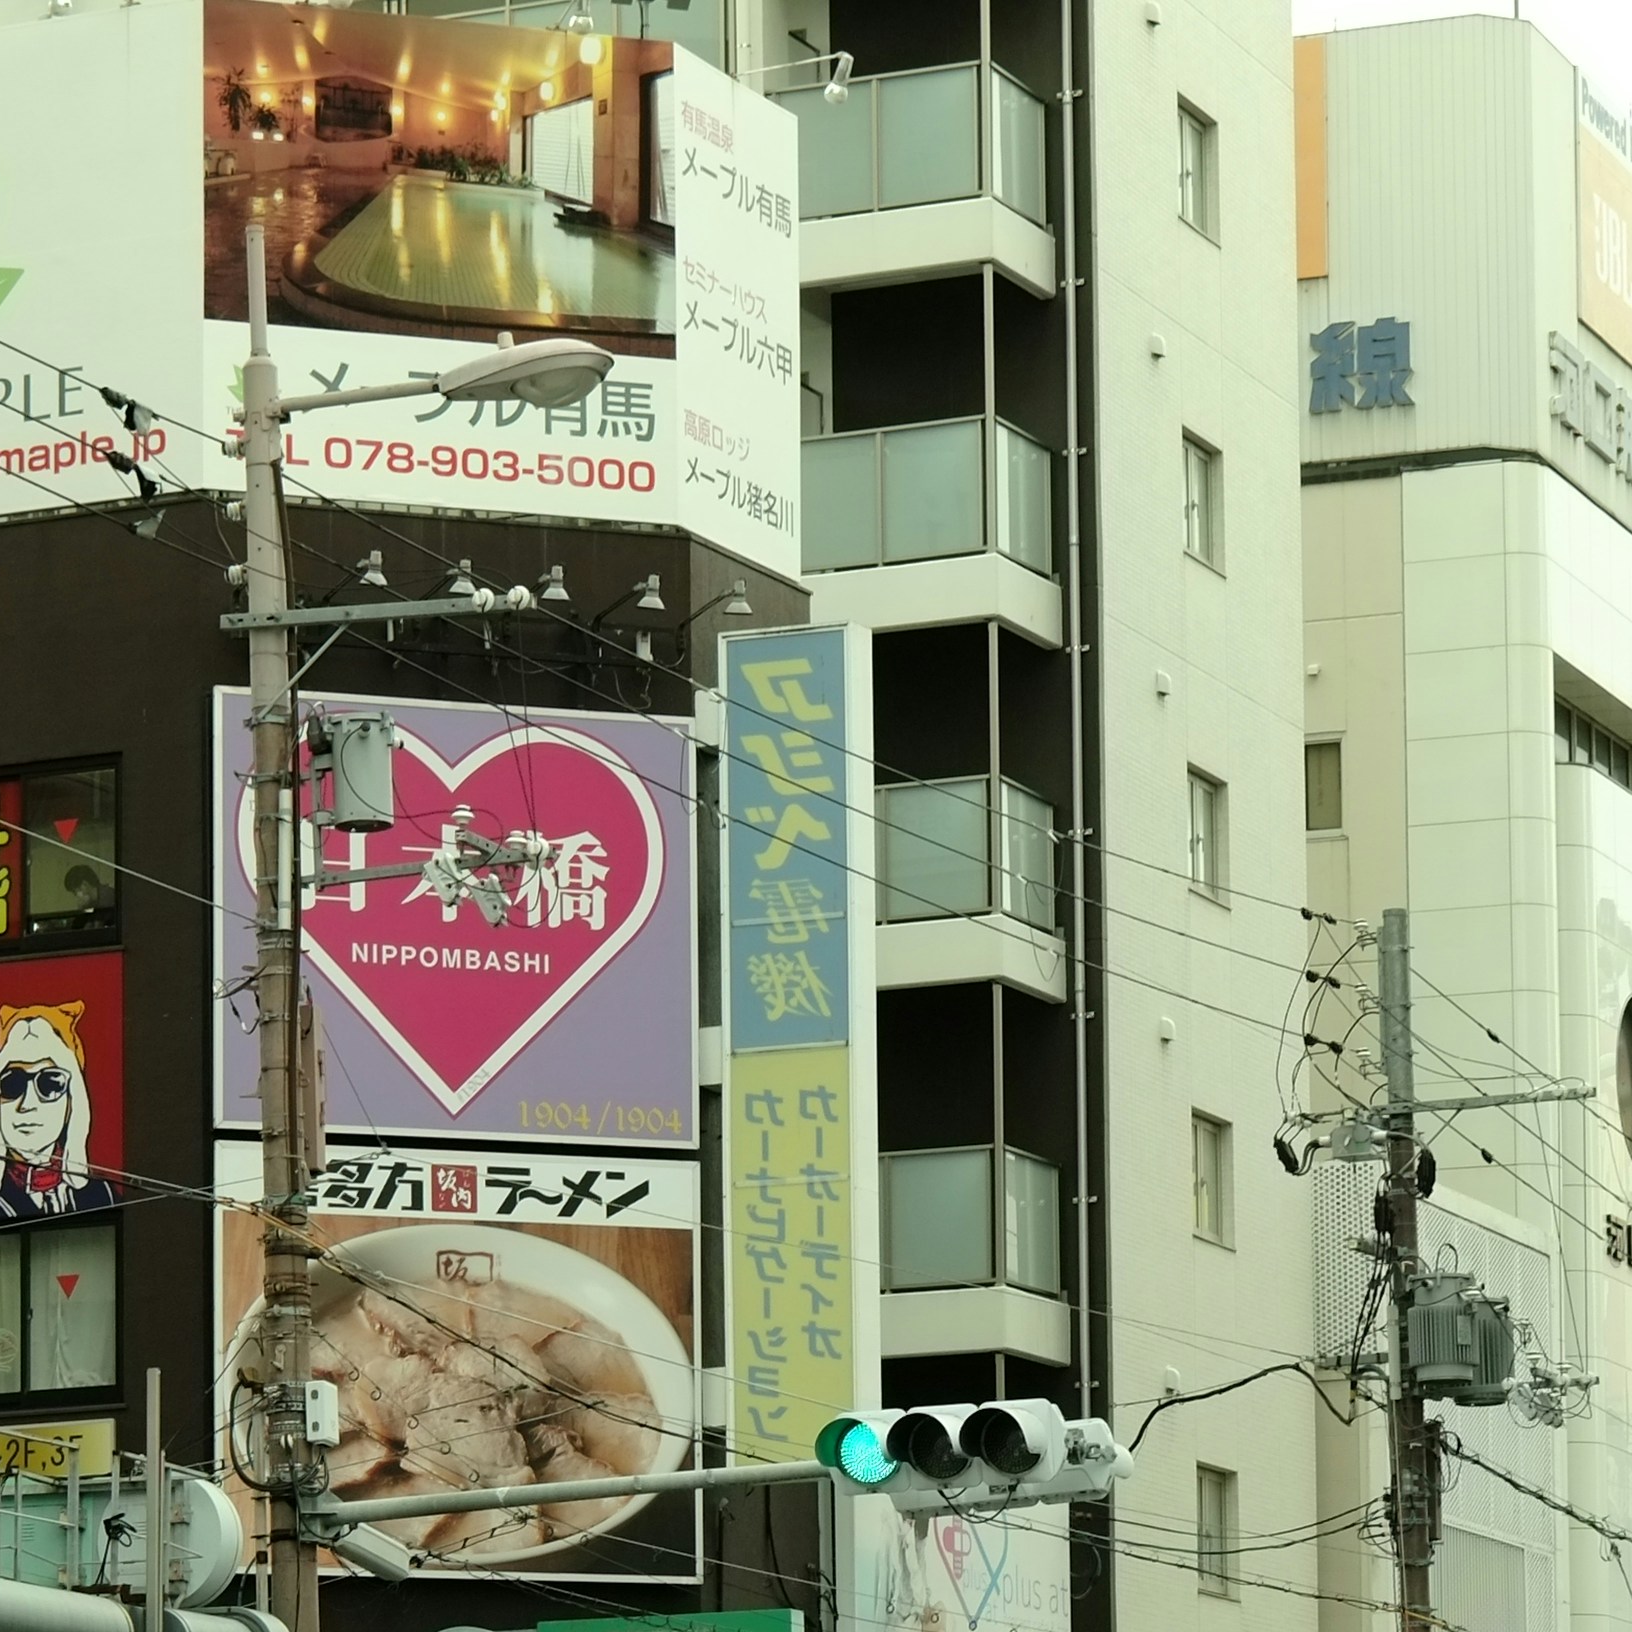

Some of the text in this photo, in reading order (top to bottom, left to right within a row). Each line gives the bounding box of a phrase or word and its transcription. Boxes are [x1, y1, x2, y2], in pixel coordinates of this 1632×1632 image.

[681, 100, 735, 155] 有馬温泉
[1581, 77, 1627, 155] Powered
[683, 147, 793, 239] メープル有馬
[683, 255, 768, 325] セミナーハウス
[683, 300, 793, 386] メープル六甲
[1309, 317, 1415, 414] 線
[324, 438, 656, 493] 078-903-5000
[684, 408, 751, 463] 高原ロッジ
[685, 457, 795, 538] メープル猪名川
[351, 942, 551, 976] NIPPOMBASHI
[308, 1159, 423, 1212] 多方
[486, 1165, 650, 1220] ラーメン
[1003, 1567, 1041, 1614] plus
